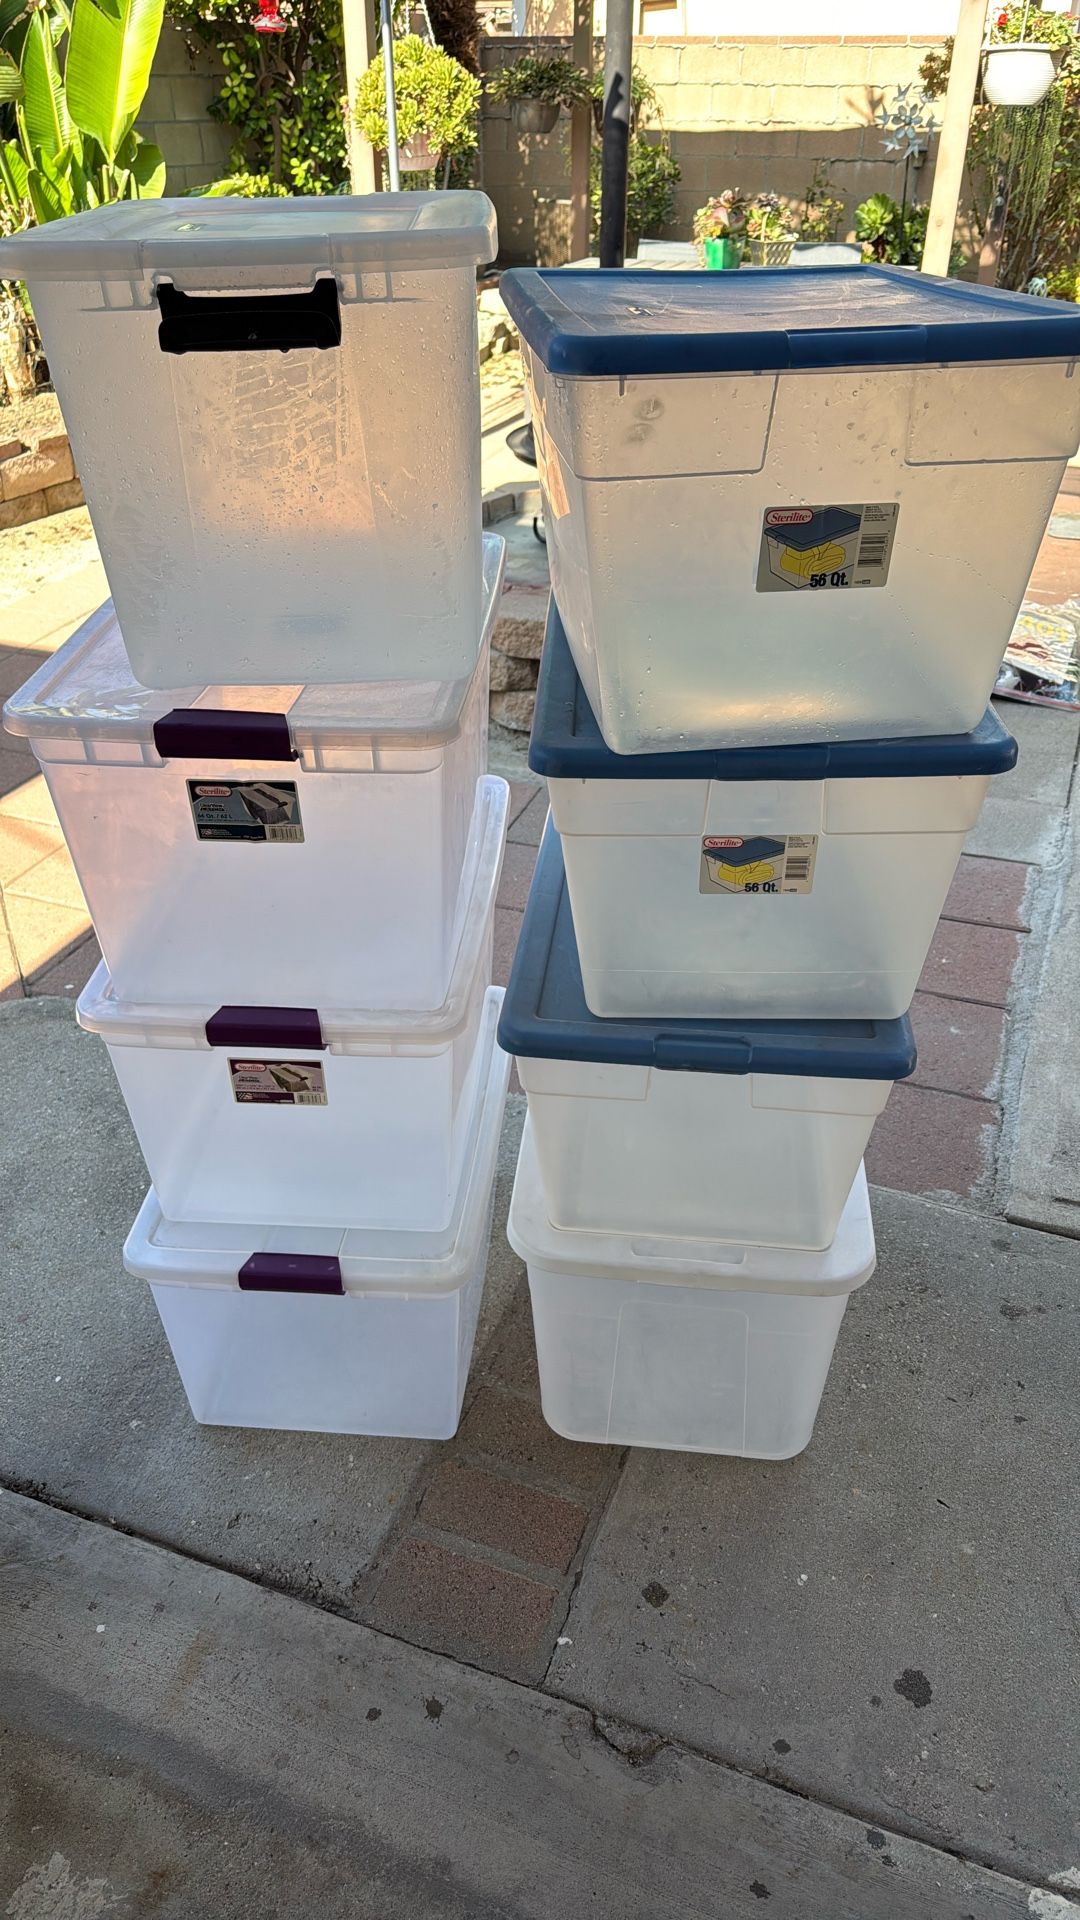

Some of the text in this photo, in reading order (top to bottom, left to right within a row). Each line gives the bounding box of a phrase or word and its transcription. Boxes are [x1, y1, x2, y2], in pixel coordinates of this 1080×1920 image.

[770, 511, 810, 523] Sterilite
[809, 571, 849, 588] 56 Qt.
[199, 786, 229, 796] Sterilite
[707, 838, 741, 847] Sterilite
[744, 882, 759, 893] 56
[762, 882, 778, 893] Qt.
